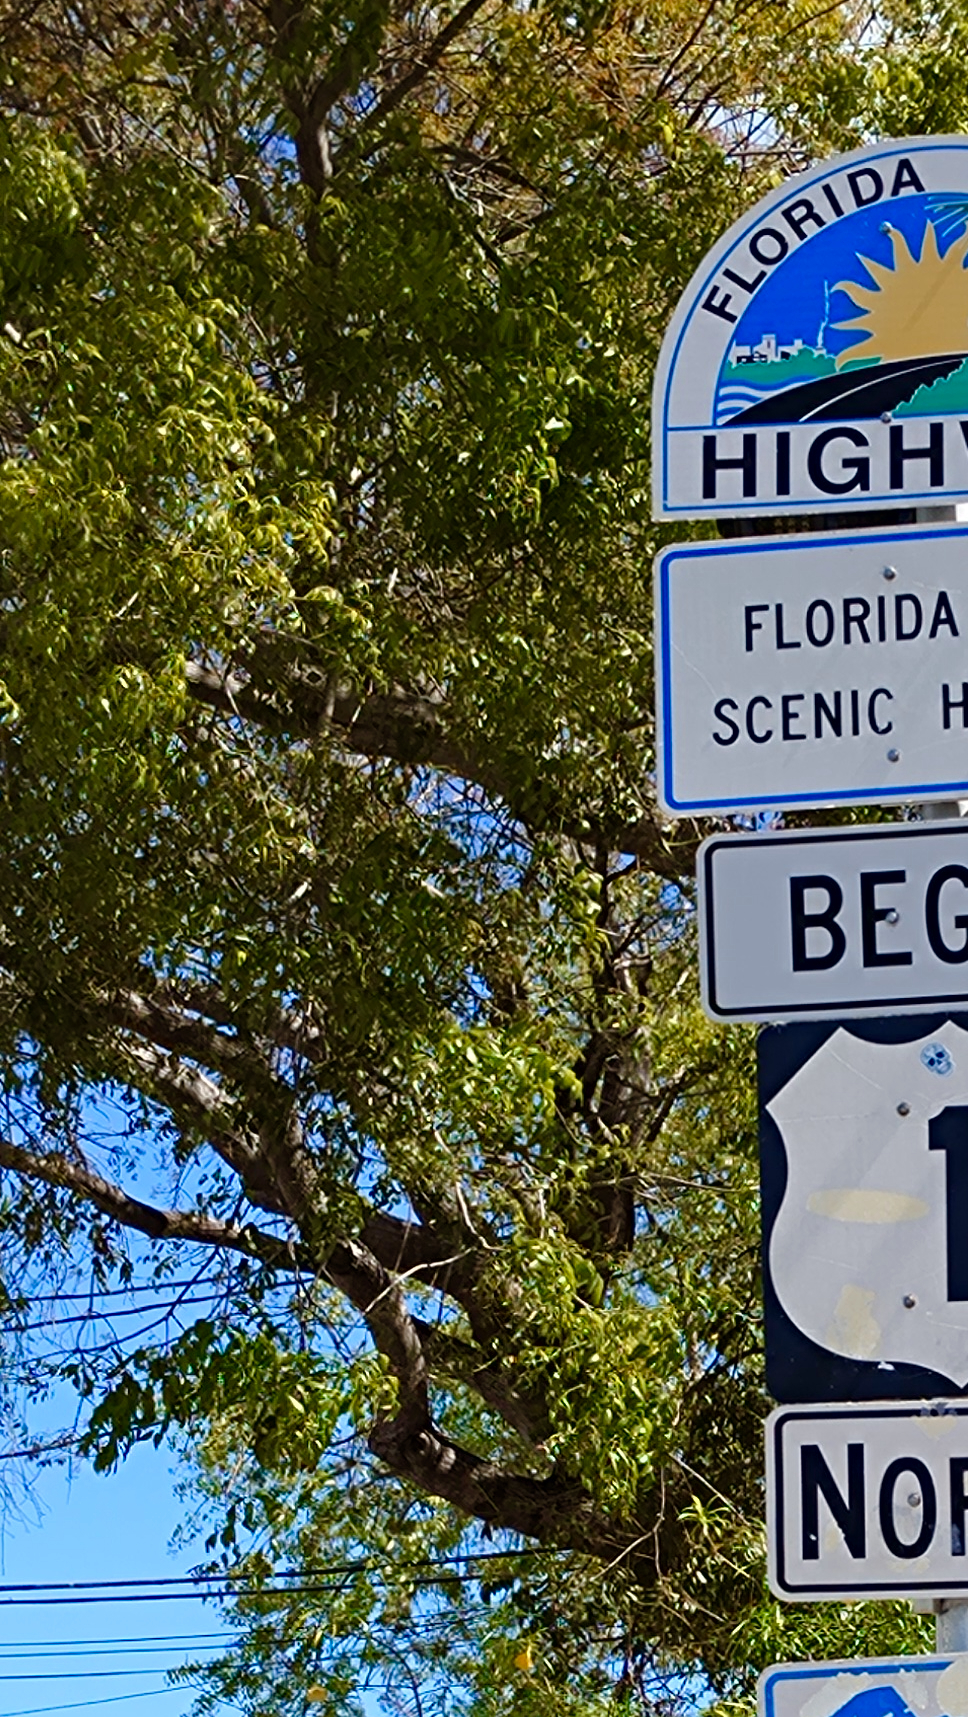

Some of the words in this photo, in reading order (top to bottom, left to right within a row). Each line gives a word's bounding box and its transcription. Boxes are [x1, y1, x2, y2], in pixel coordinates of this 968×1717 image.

[702, 157, 925, 324] FLORIDA
[744, 590, 959, 652] FLORIDA
[712, 687, 895, 746] SCENIC
